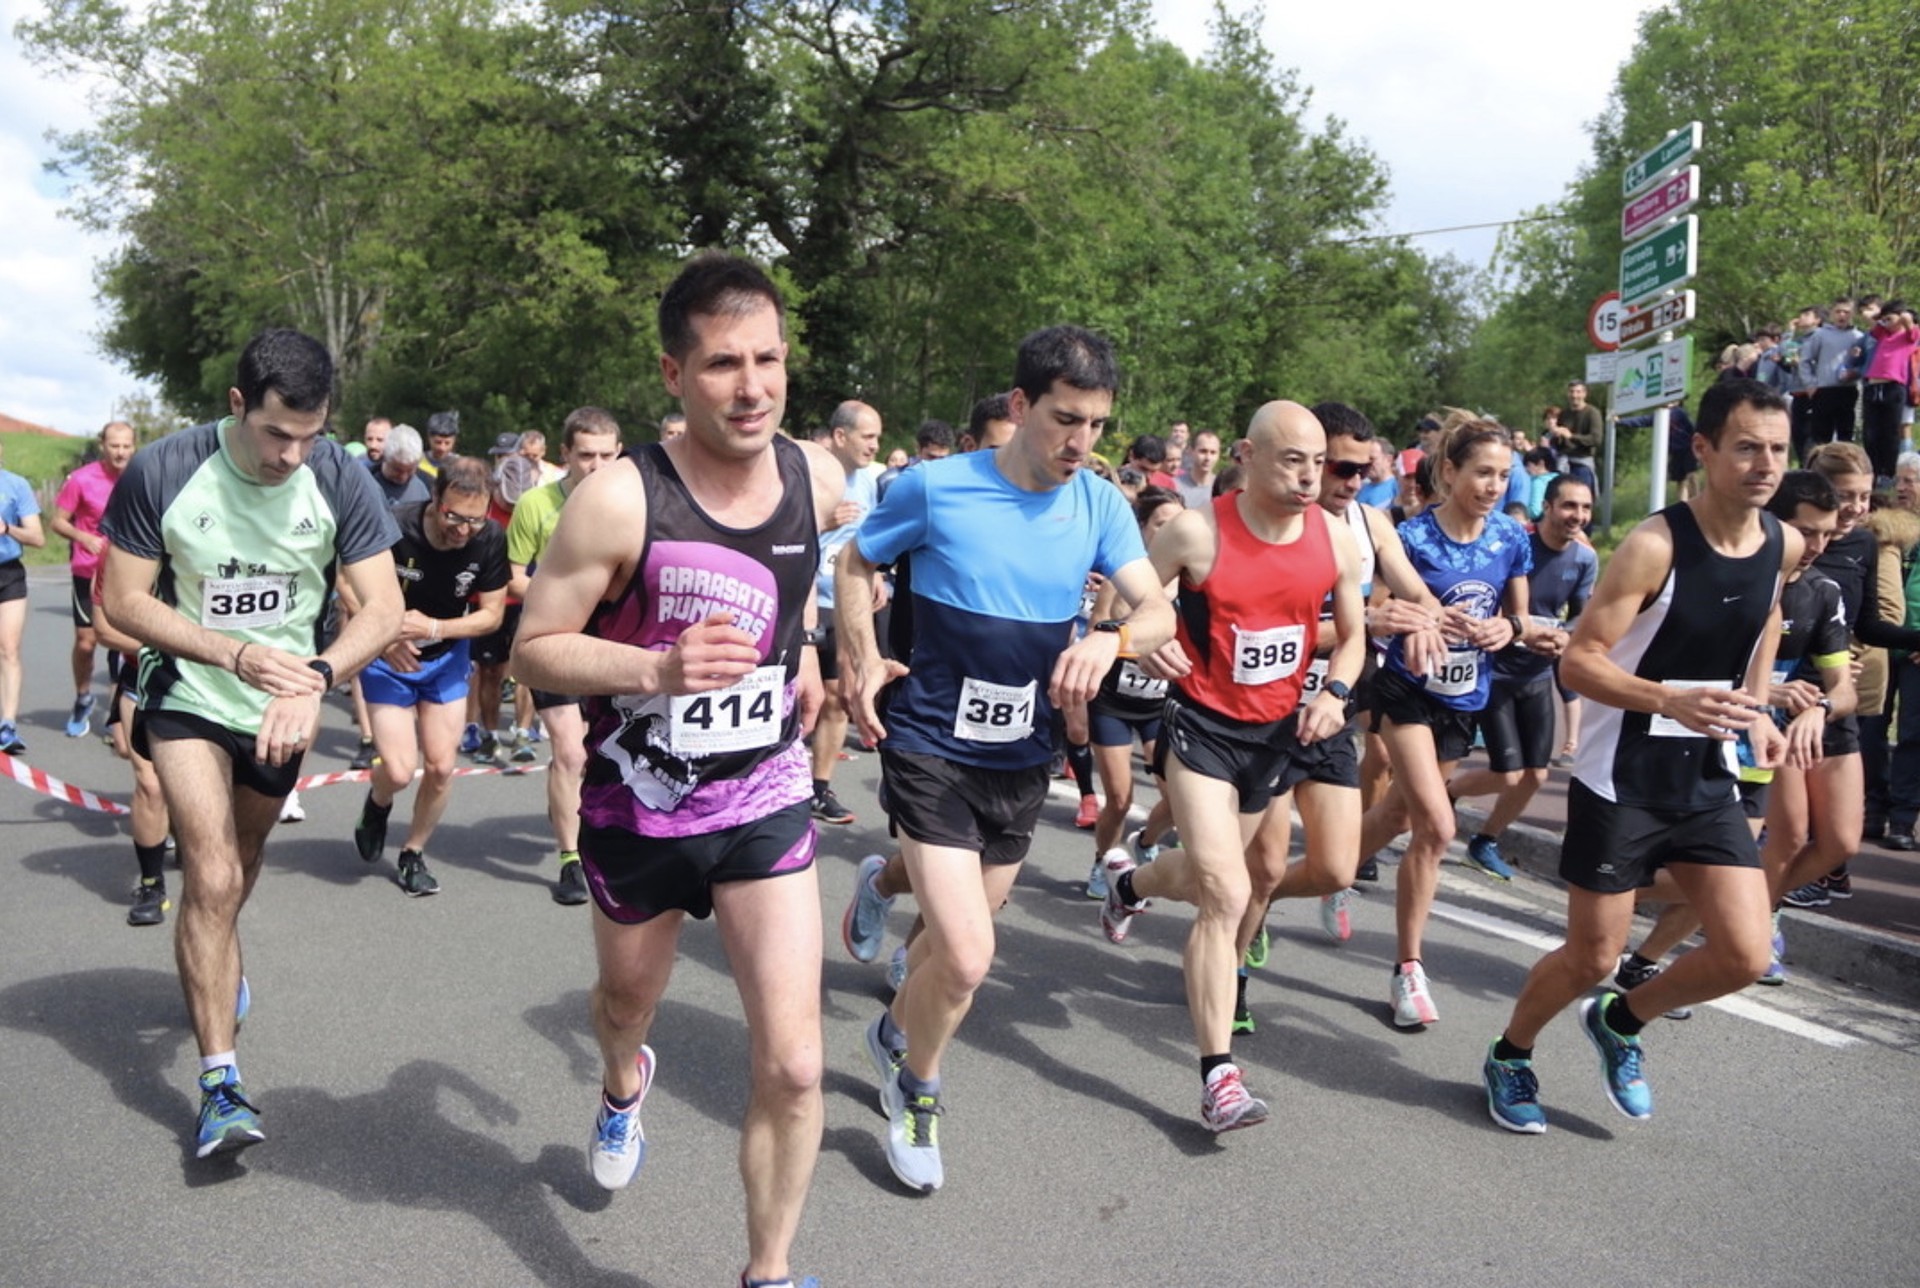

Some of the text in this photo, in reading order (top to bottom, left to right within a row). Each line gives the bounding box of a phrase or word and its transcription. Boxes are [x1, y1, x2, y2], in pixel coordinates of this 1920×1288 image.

[1598, 312, 1617, 331] 15
[210, 590, 280, 616] 380
[659, 566, 776, 621] ARRASATE
[1242, 641, 1297, 669] 398
[683, 690, 774, 730] 414
[965, 698, 1030, 726] 381
